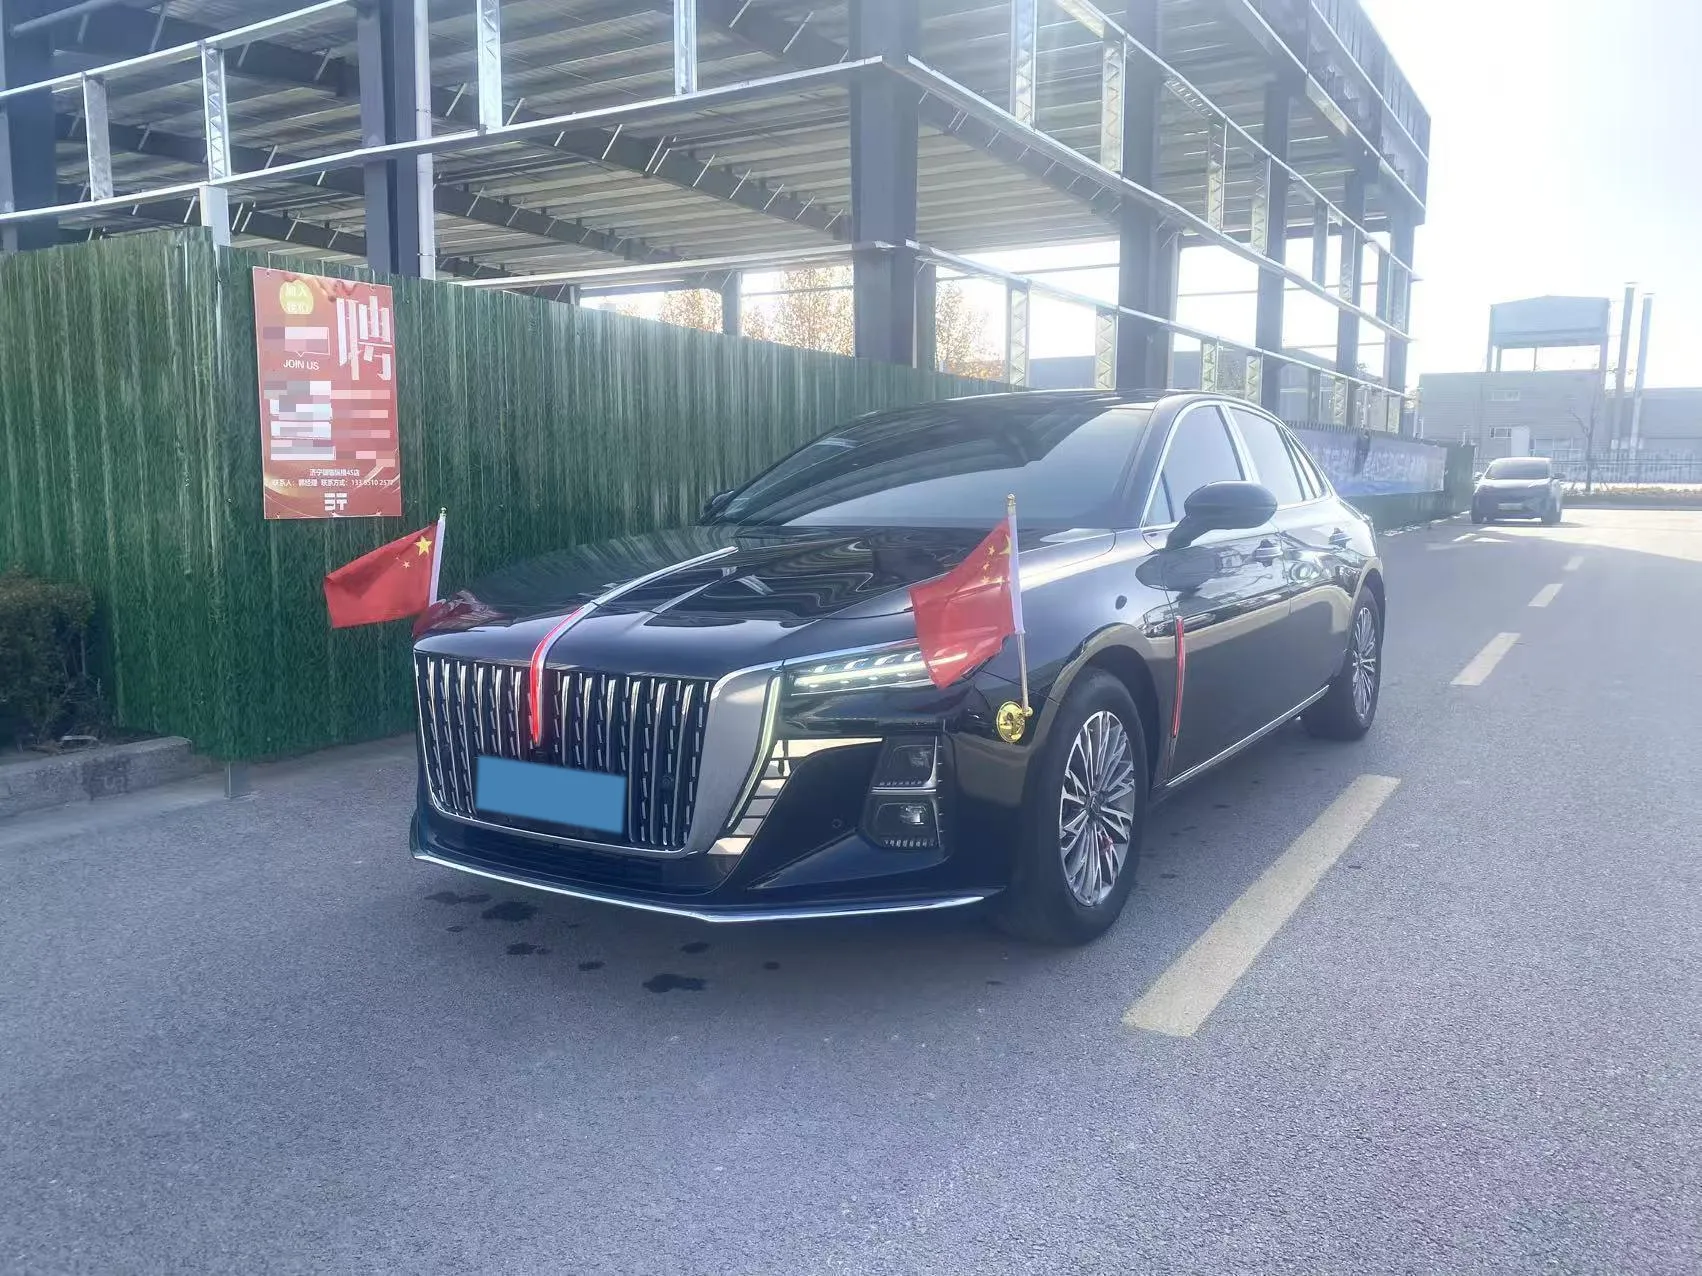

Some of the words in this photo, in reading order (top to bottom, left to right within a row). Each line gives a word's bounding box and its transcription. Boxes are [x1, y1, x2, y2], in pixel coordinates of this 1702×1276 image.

[336, 295, 392, 381] 聘
[283, 359, 305, 369] JOIN
[306, 361, 320, 371] US
